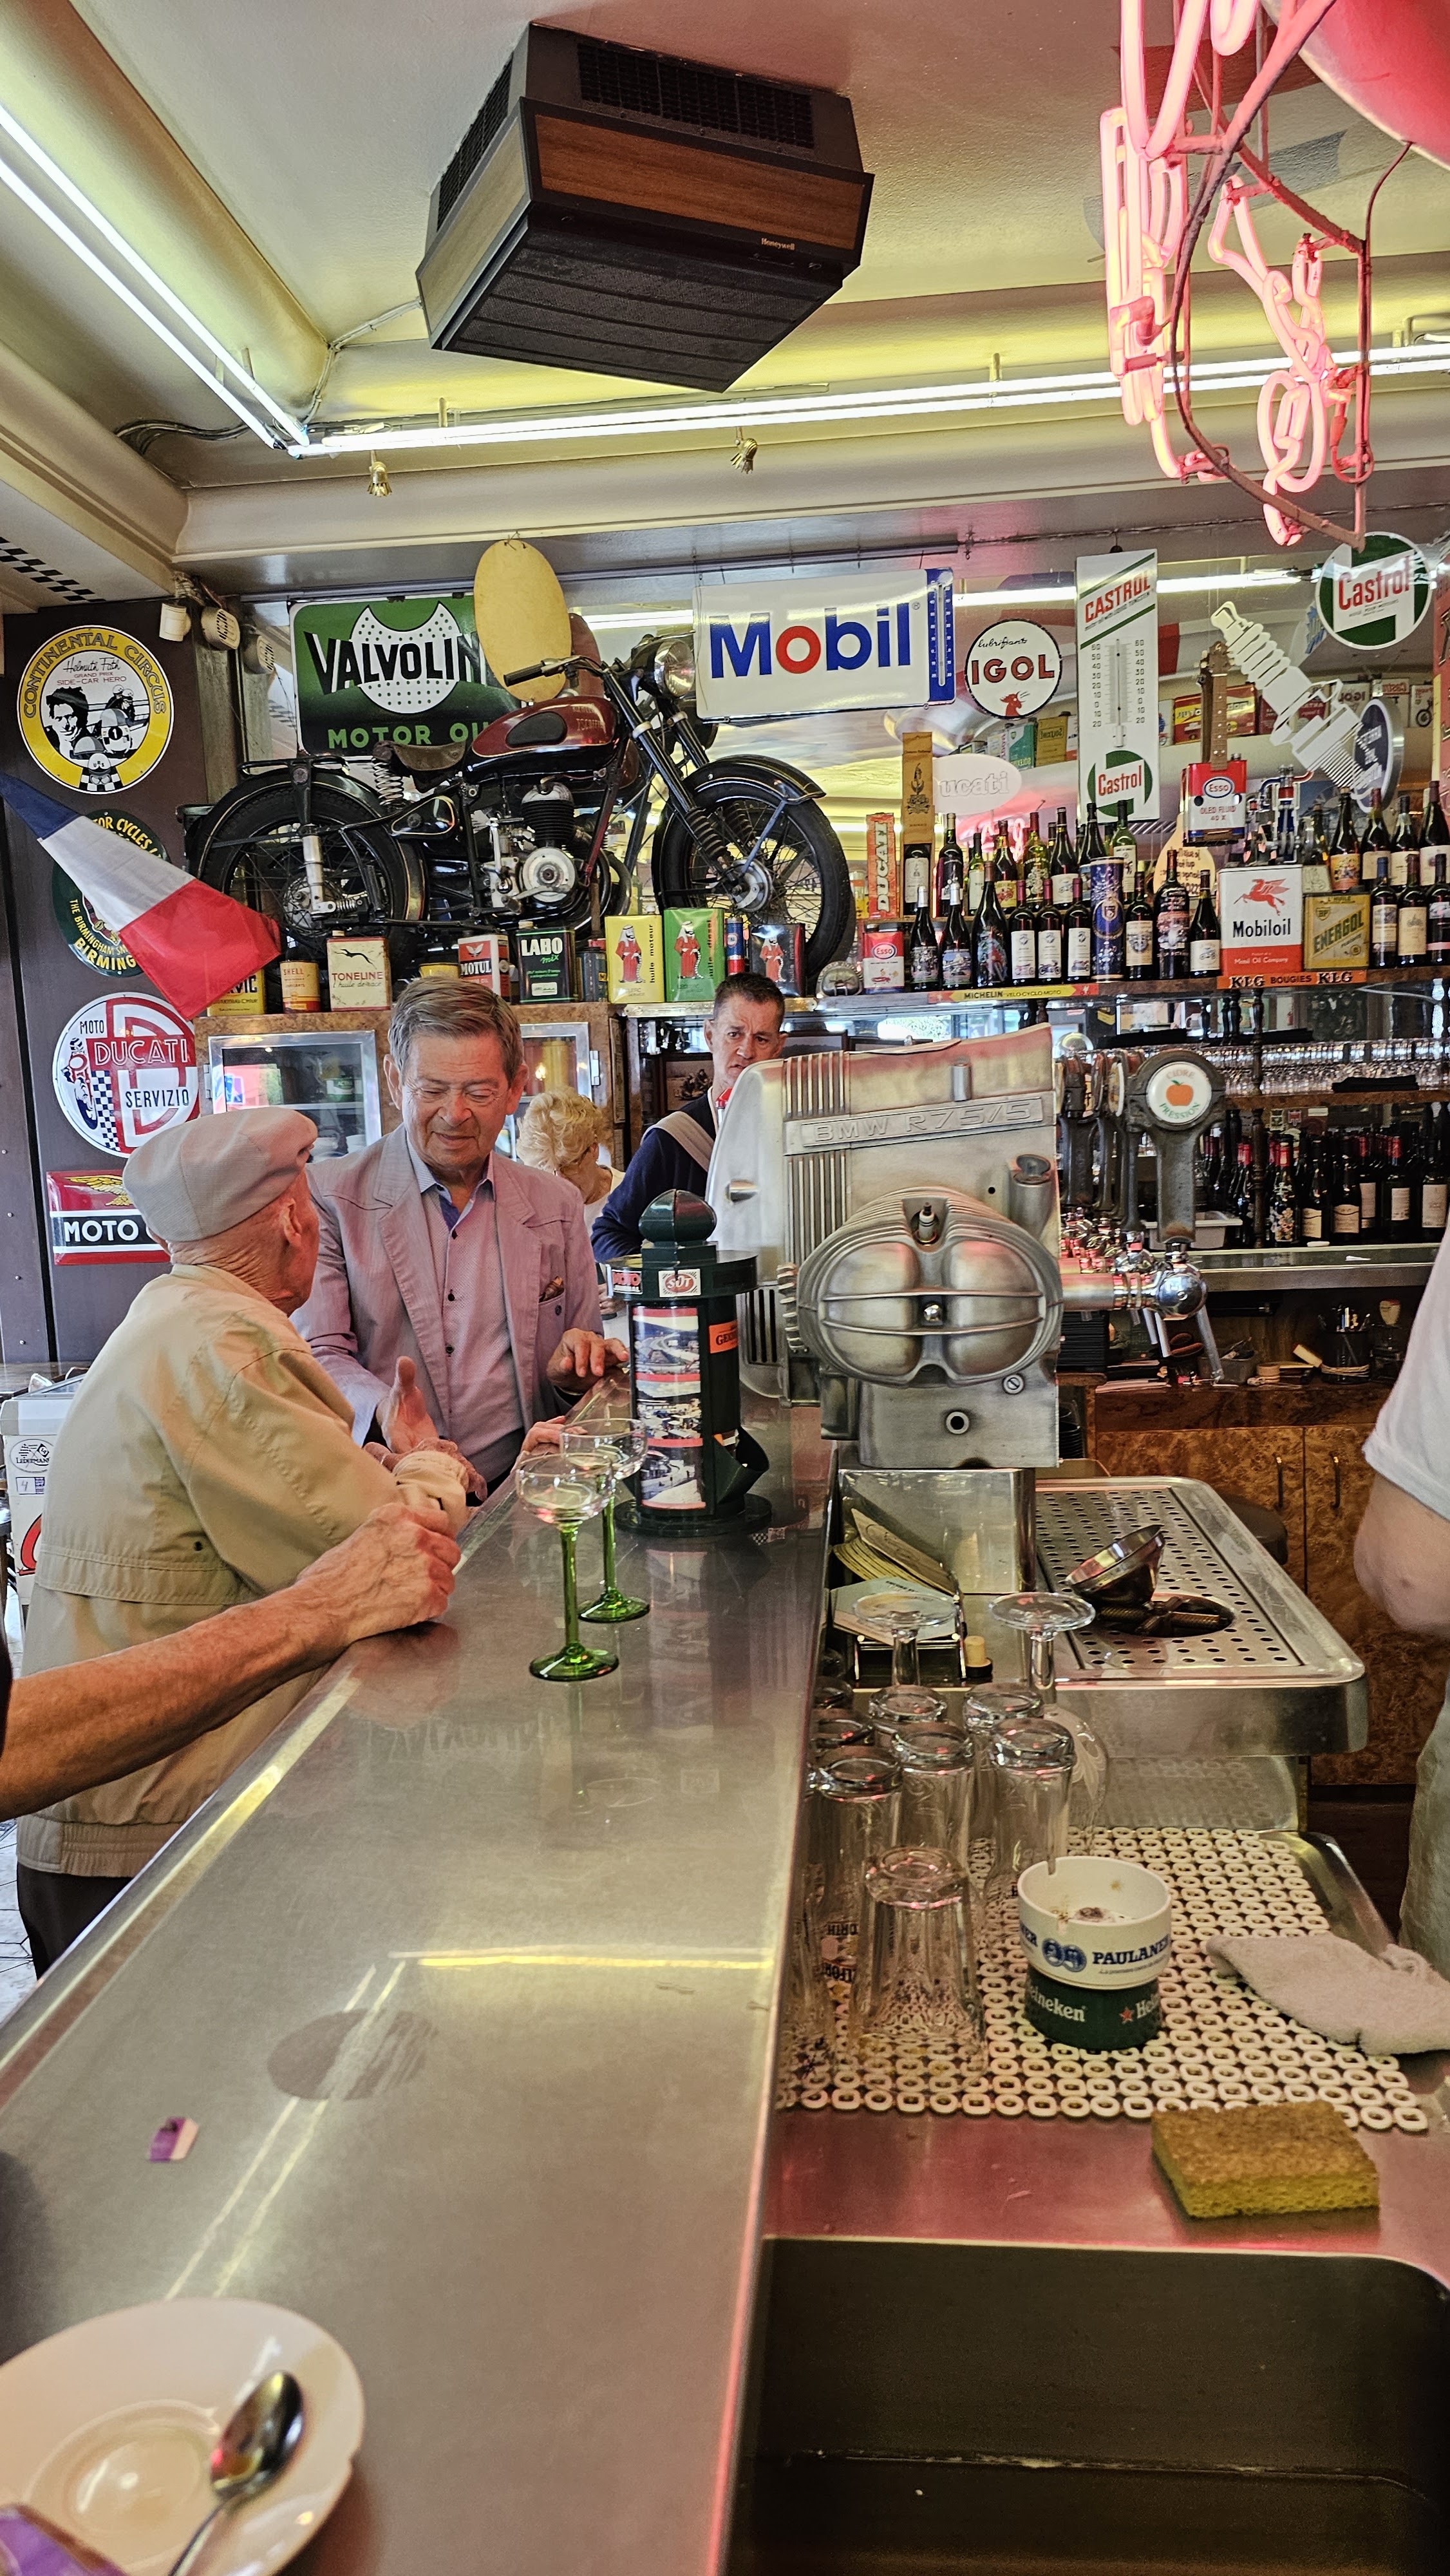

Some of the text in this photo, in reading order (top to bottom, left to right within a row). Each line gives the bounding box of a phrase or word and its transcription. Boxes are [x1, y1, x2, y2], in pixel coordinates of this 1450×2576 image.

[1338, 556, 1409, 611] Castrol
[1085, 573, 1151, 623] CASTROL
[709, 603, 910, 679] Mobil
[24, 632, 166, 718] CONTINENTAL CIRCUS
[303, 631, 485, 695] VALVOLIN
[971, 654, 1055, 685] IGOL
[112, 728, 117, 739] 1
[328, 724, 432, 750] MOTOR
[939, 770, 1010, 797] ucati
[1097, 764, 1142, 797] Castrol
[1209, 784, 1229, 793] Esso
[117, 818, 153, 850] CYCLES
[69, 899, 80, 914] THE
[74, 915, 115, 956] BIRMINGHAM
[1232, 918, 1291, 938] Mobiloil
[1314, 910, 1364, 954] ENERGOL
[74, 937, 137, 971] BIRMING
[521, 938, 563, 956] LABO
[540, 954, 560, 964] mix
[331, 971, 384, 981] TONELINE
[460, 960, 492, 976] MOTUL
[1230, 971, 1353, 989] KLG BOUGIES KLG
[964, 991, 1003, 999] MICHELIN
[79, 1019, 104, 1035] MOTO
[93, 1038, 189, 1066] DUCATI
[1166, 1069, 1195, 1081] CIDRE
[125, 1088, 189, 1108] SERVIZIO
[813, 1101, 1031, 1142] BMW R75/5
[1159, 1102, 1201, 1120] PRESSION
[64, 1219, 139, 1244] MOTO
[21, 1481, 28, 1491] 4
